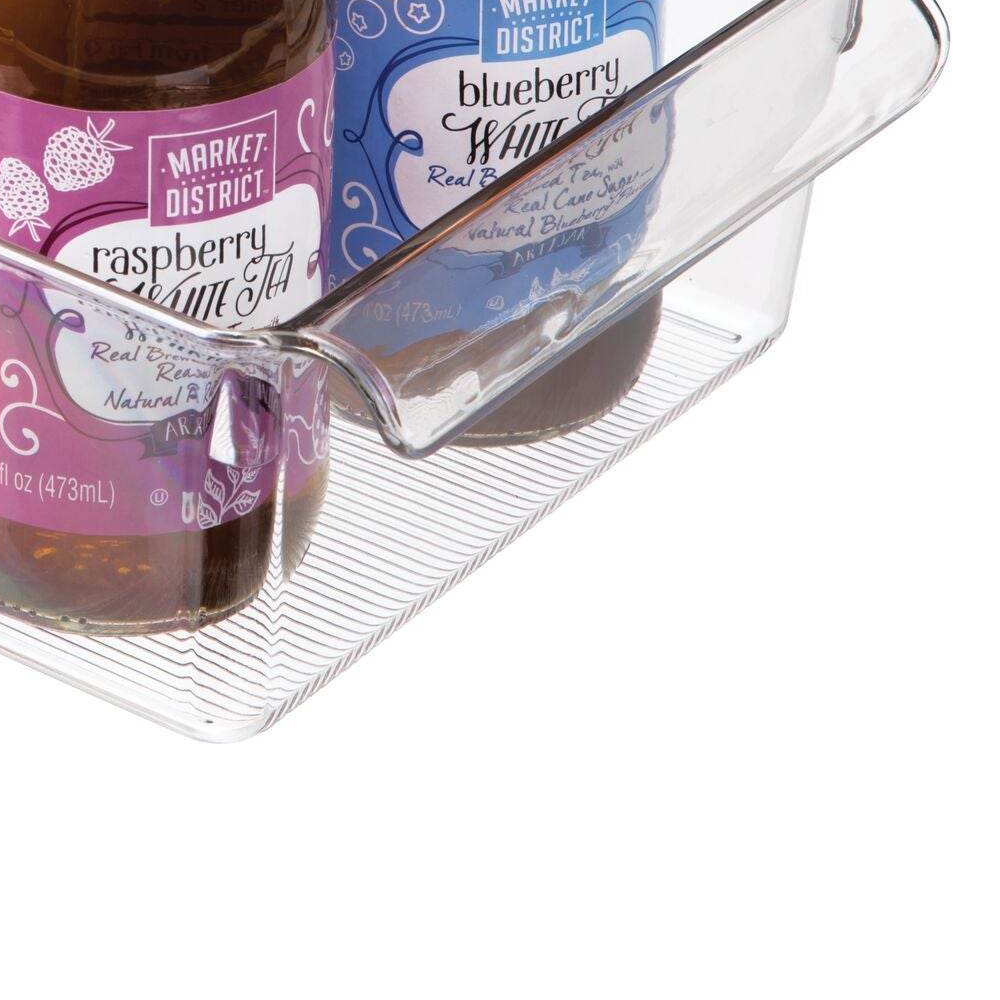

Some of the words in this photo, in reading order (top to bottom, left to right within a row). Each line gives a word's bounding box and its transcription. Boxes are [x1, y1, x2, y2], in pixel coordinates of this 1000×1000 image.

[496, 12, 595, 56] DISTRICT
[458, 57, 620, 108] blueberry
[166, 132, 267, 180] MARKET
[427, 164, 475, 189] Real
[166, 168, 264, 218] DISTRICT
[553, 187, 593, 211] Cane
[92, 224, 266, 284] raspberry
[235, 241, 295, 318] TEA
[91, 341, 141, 363] Real
[146, 345, 196, 362] Brew
[155, 362, 193, 383] Rea
[103, 387, 183, 411] Natural
[0, 462, 9, 486] fl
[14, 473, 32, 493] oz
[38, 475, 116, 509] (473mL)
